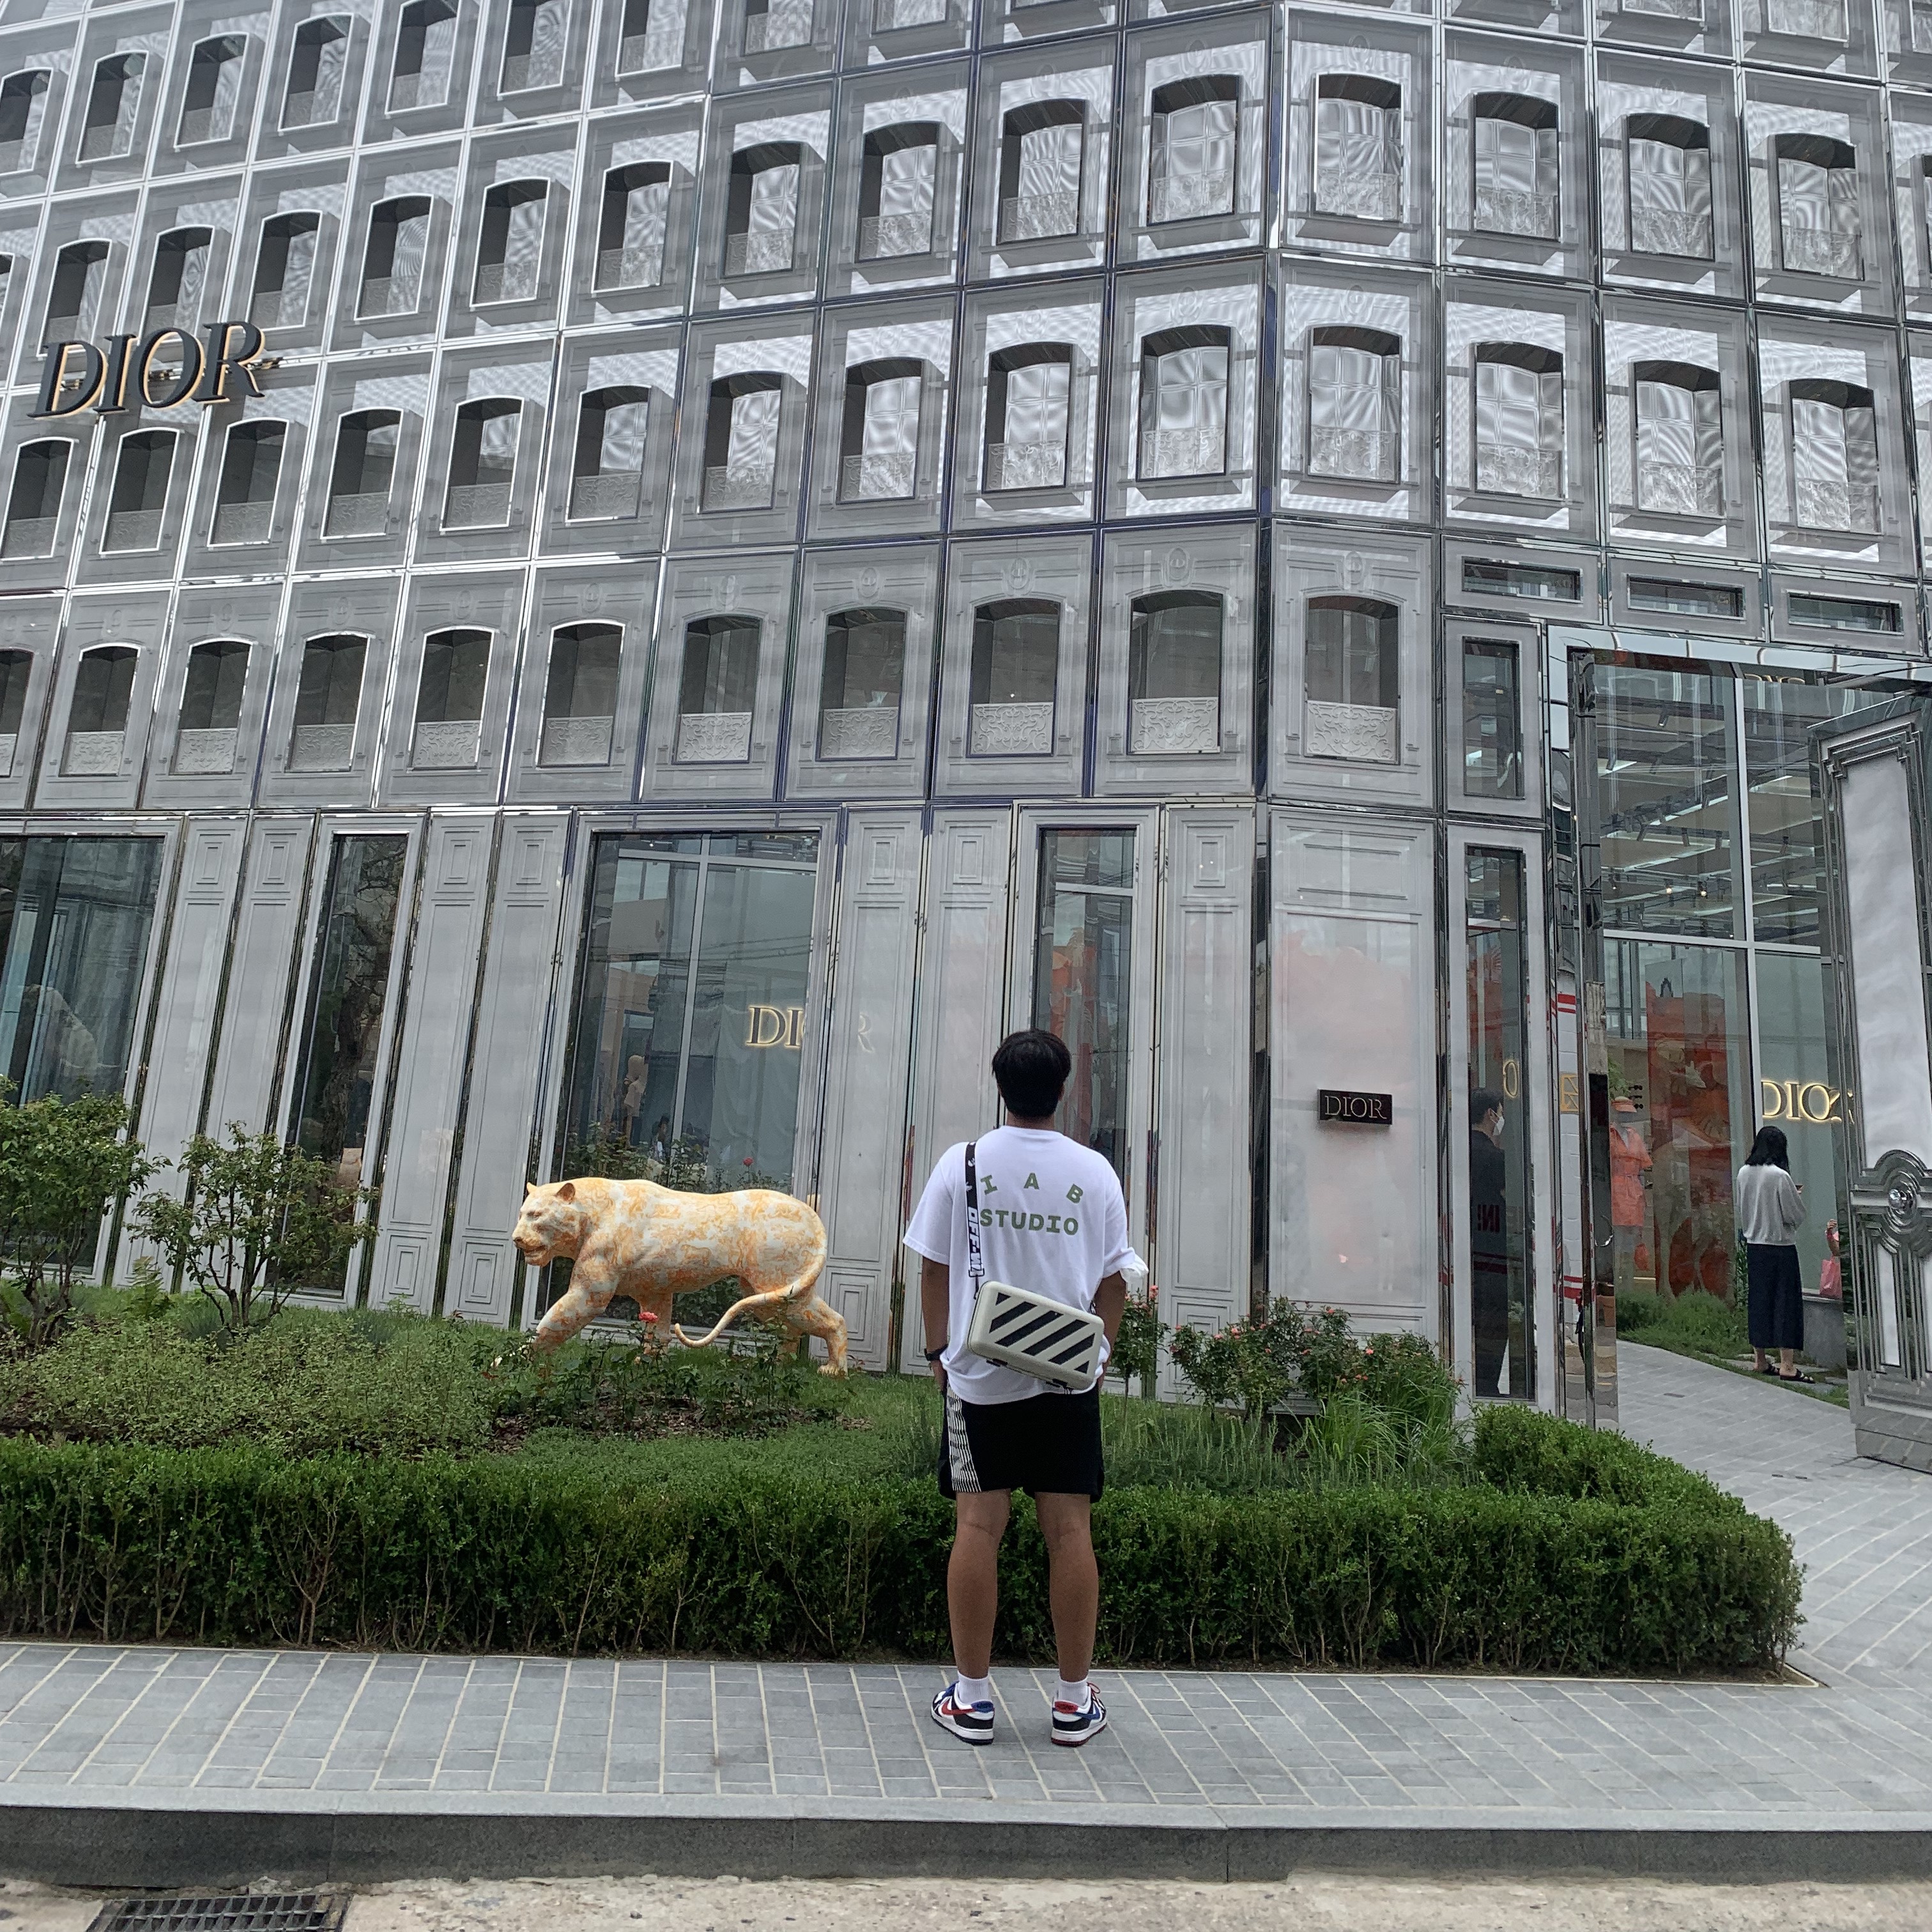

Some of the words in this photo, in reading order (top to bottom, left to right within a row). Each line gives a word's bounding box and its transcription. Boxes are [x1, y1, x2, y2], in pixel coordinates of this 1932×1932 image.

[27, 321, 265, 420] DIOR
[1324, 1095, 1387, 1119] DIOR
[980, 1208, 1079, 1236] STUDIO
